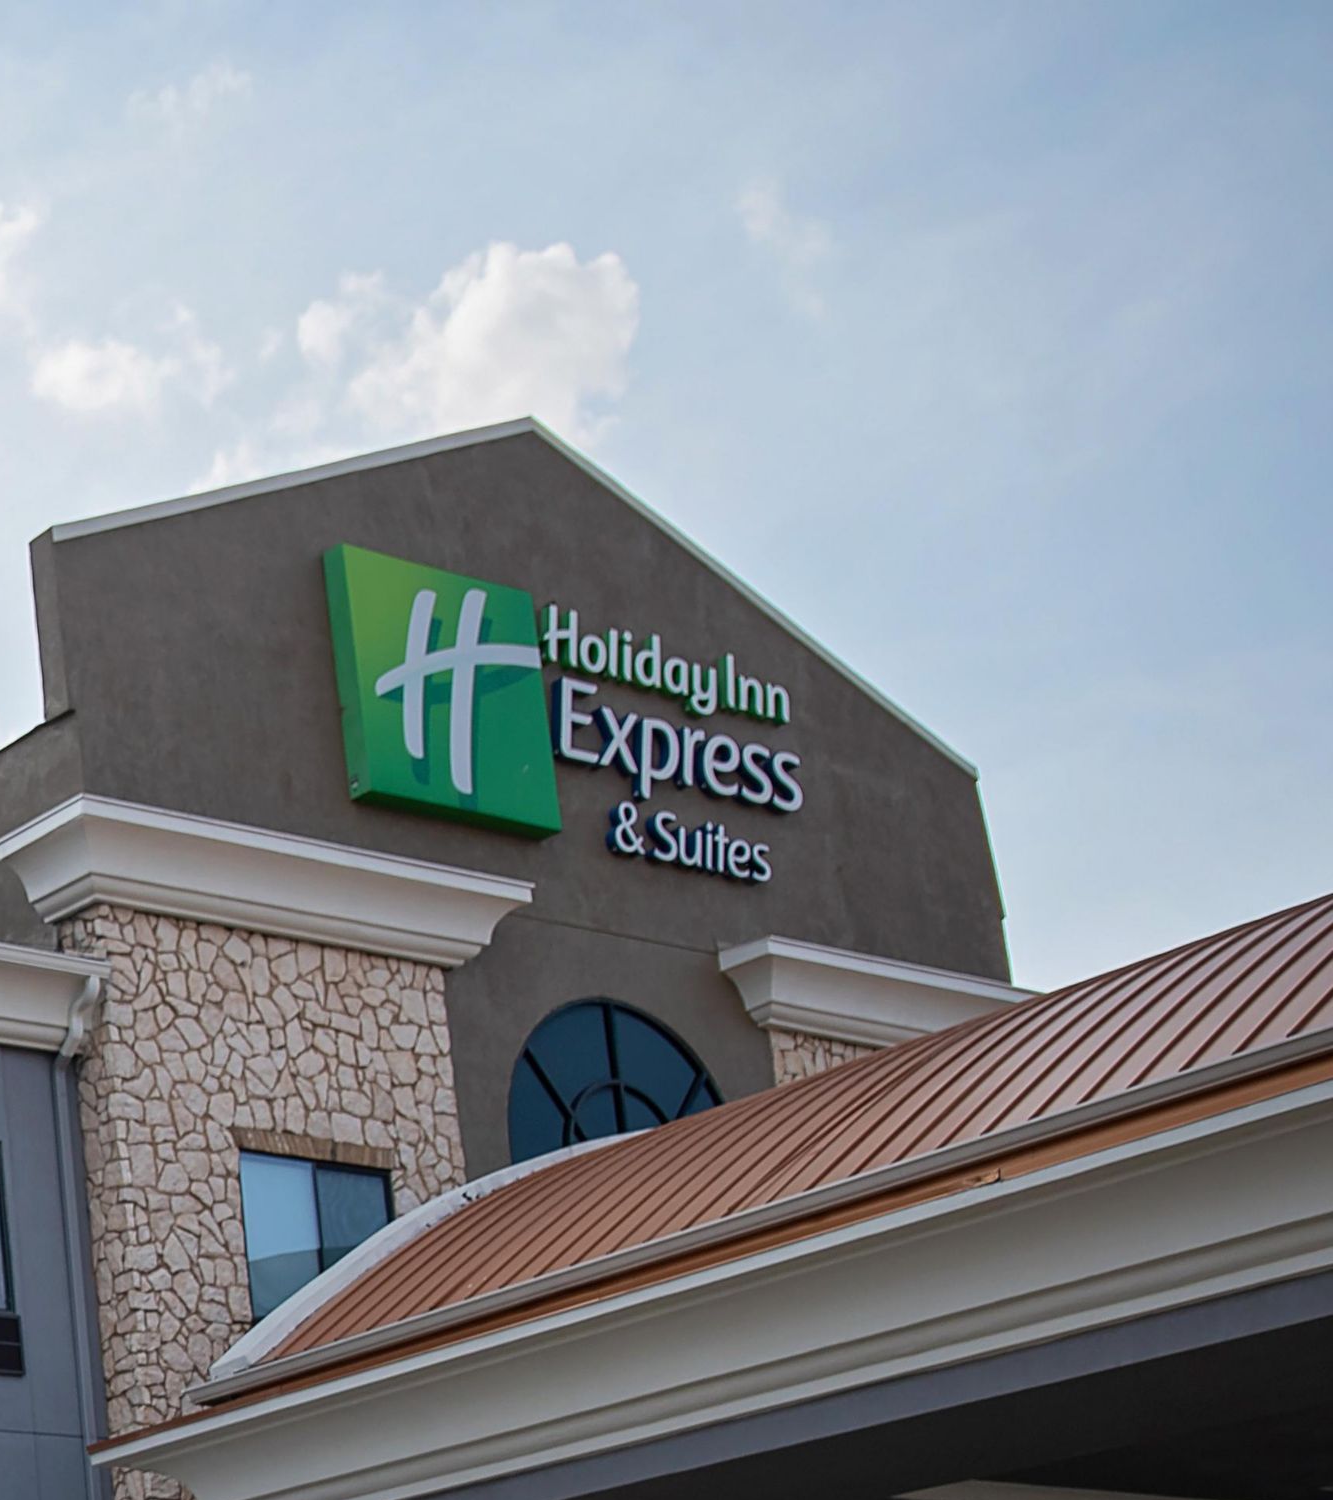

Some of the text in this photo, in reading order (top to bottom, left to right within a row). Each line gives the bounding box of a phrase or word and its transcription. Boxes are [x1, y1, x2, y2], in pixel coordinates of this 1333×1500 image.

[541, 603, 791, 723] Holiday Inn
[556, 676, 804, 812] Express
[611, 801, 773, 883] & Suites
